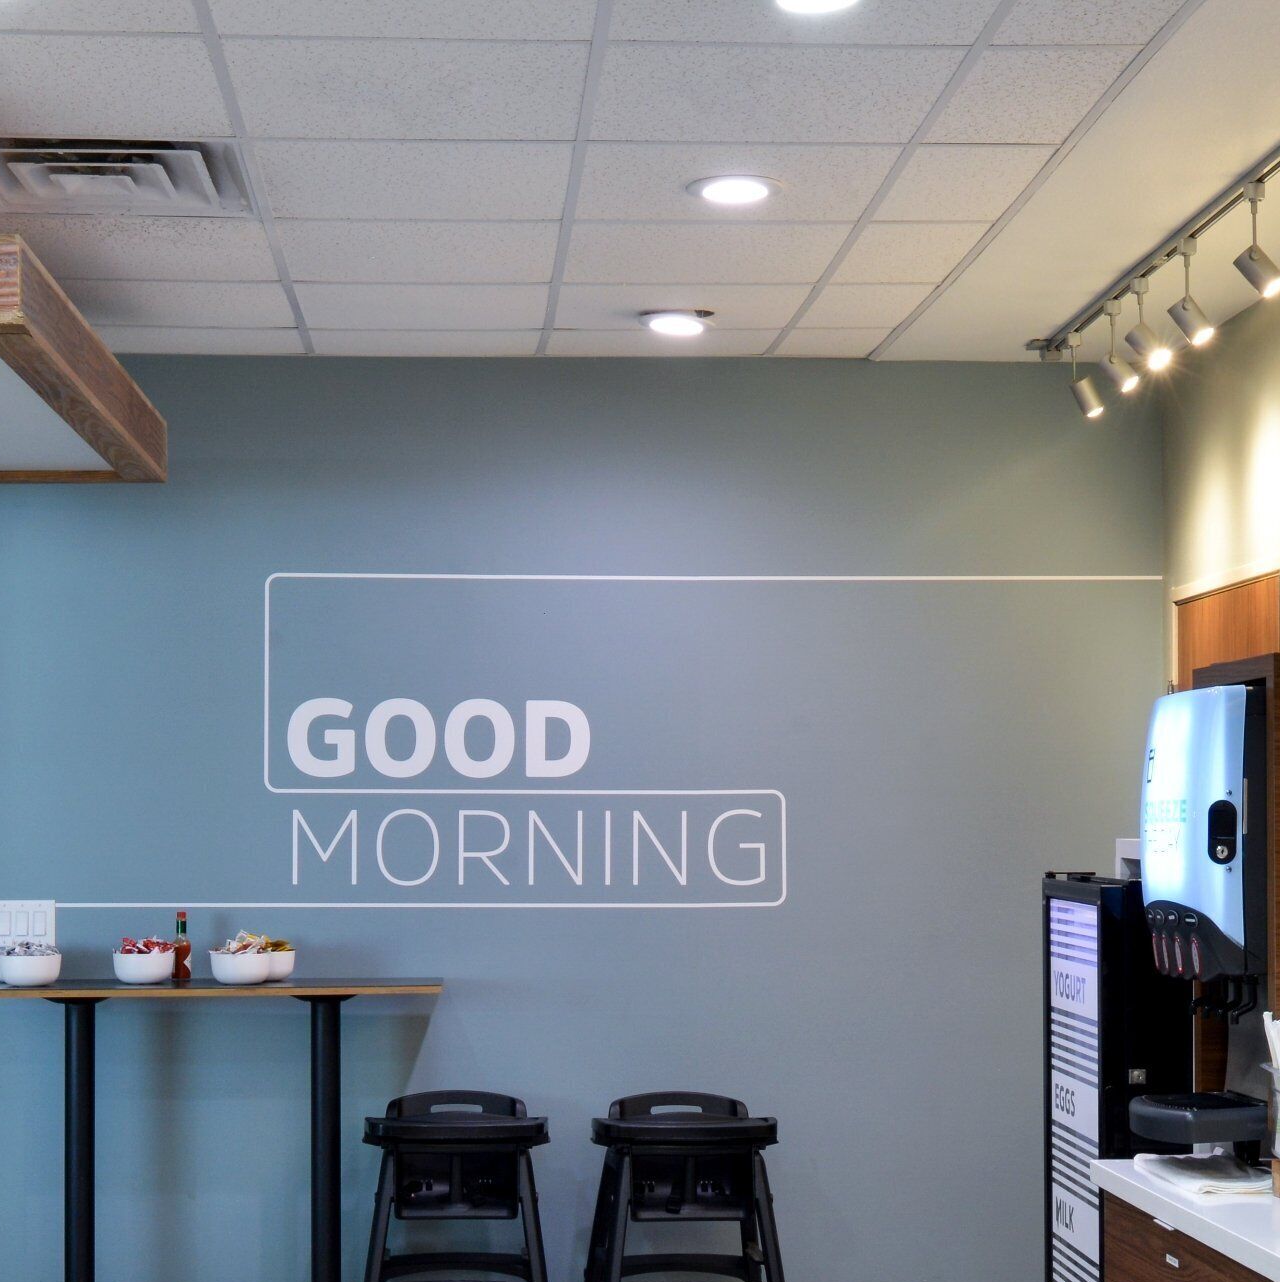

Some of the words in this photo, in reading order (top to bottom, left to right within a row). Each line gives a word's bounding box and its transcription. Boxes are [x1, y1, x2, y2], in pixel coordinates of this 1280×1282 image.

[286, 697, 591, 779] GOOD
[292, 808, 767, 887] MORNING
[1053, 970, 1087, 1005] YOGURT
[1054, 1083, 1076, 1118] EGGS
[1055, 1196, 1075, 1233] MILK
